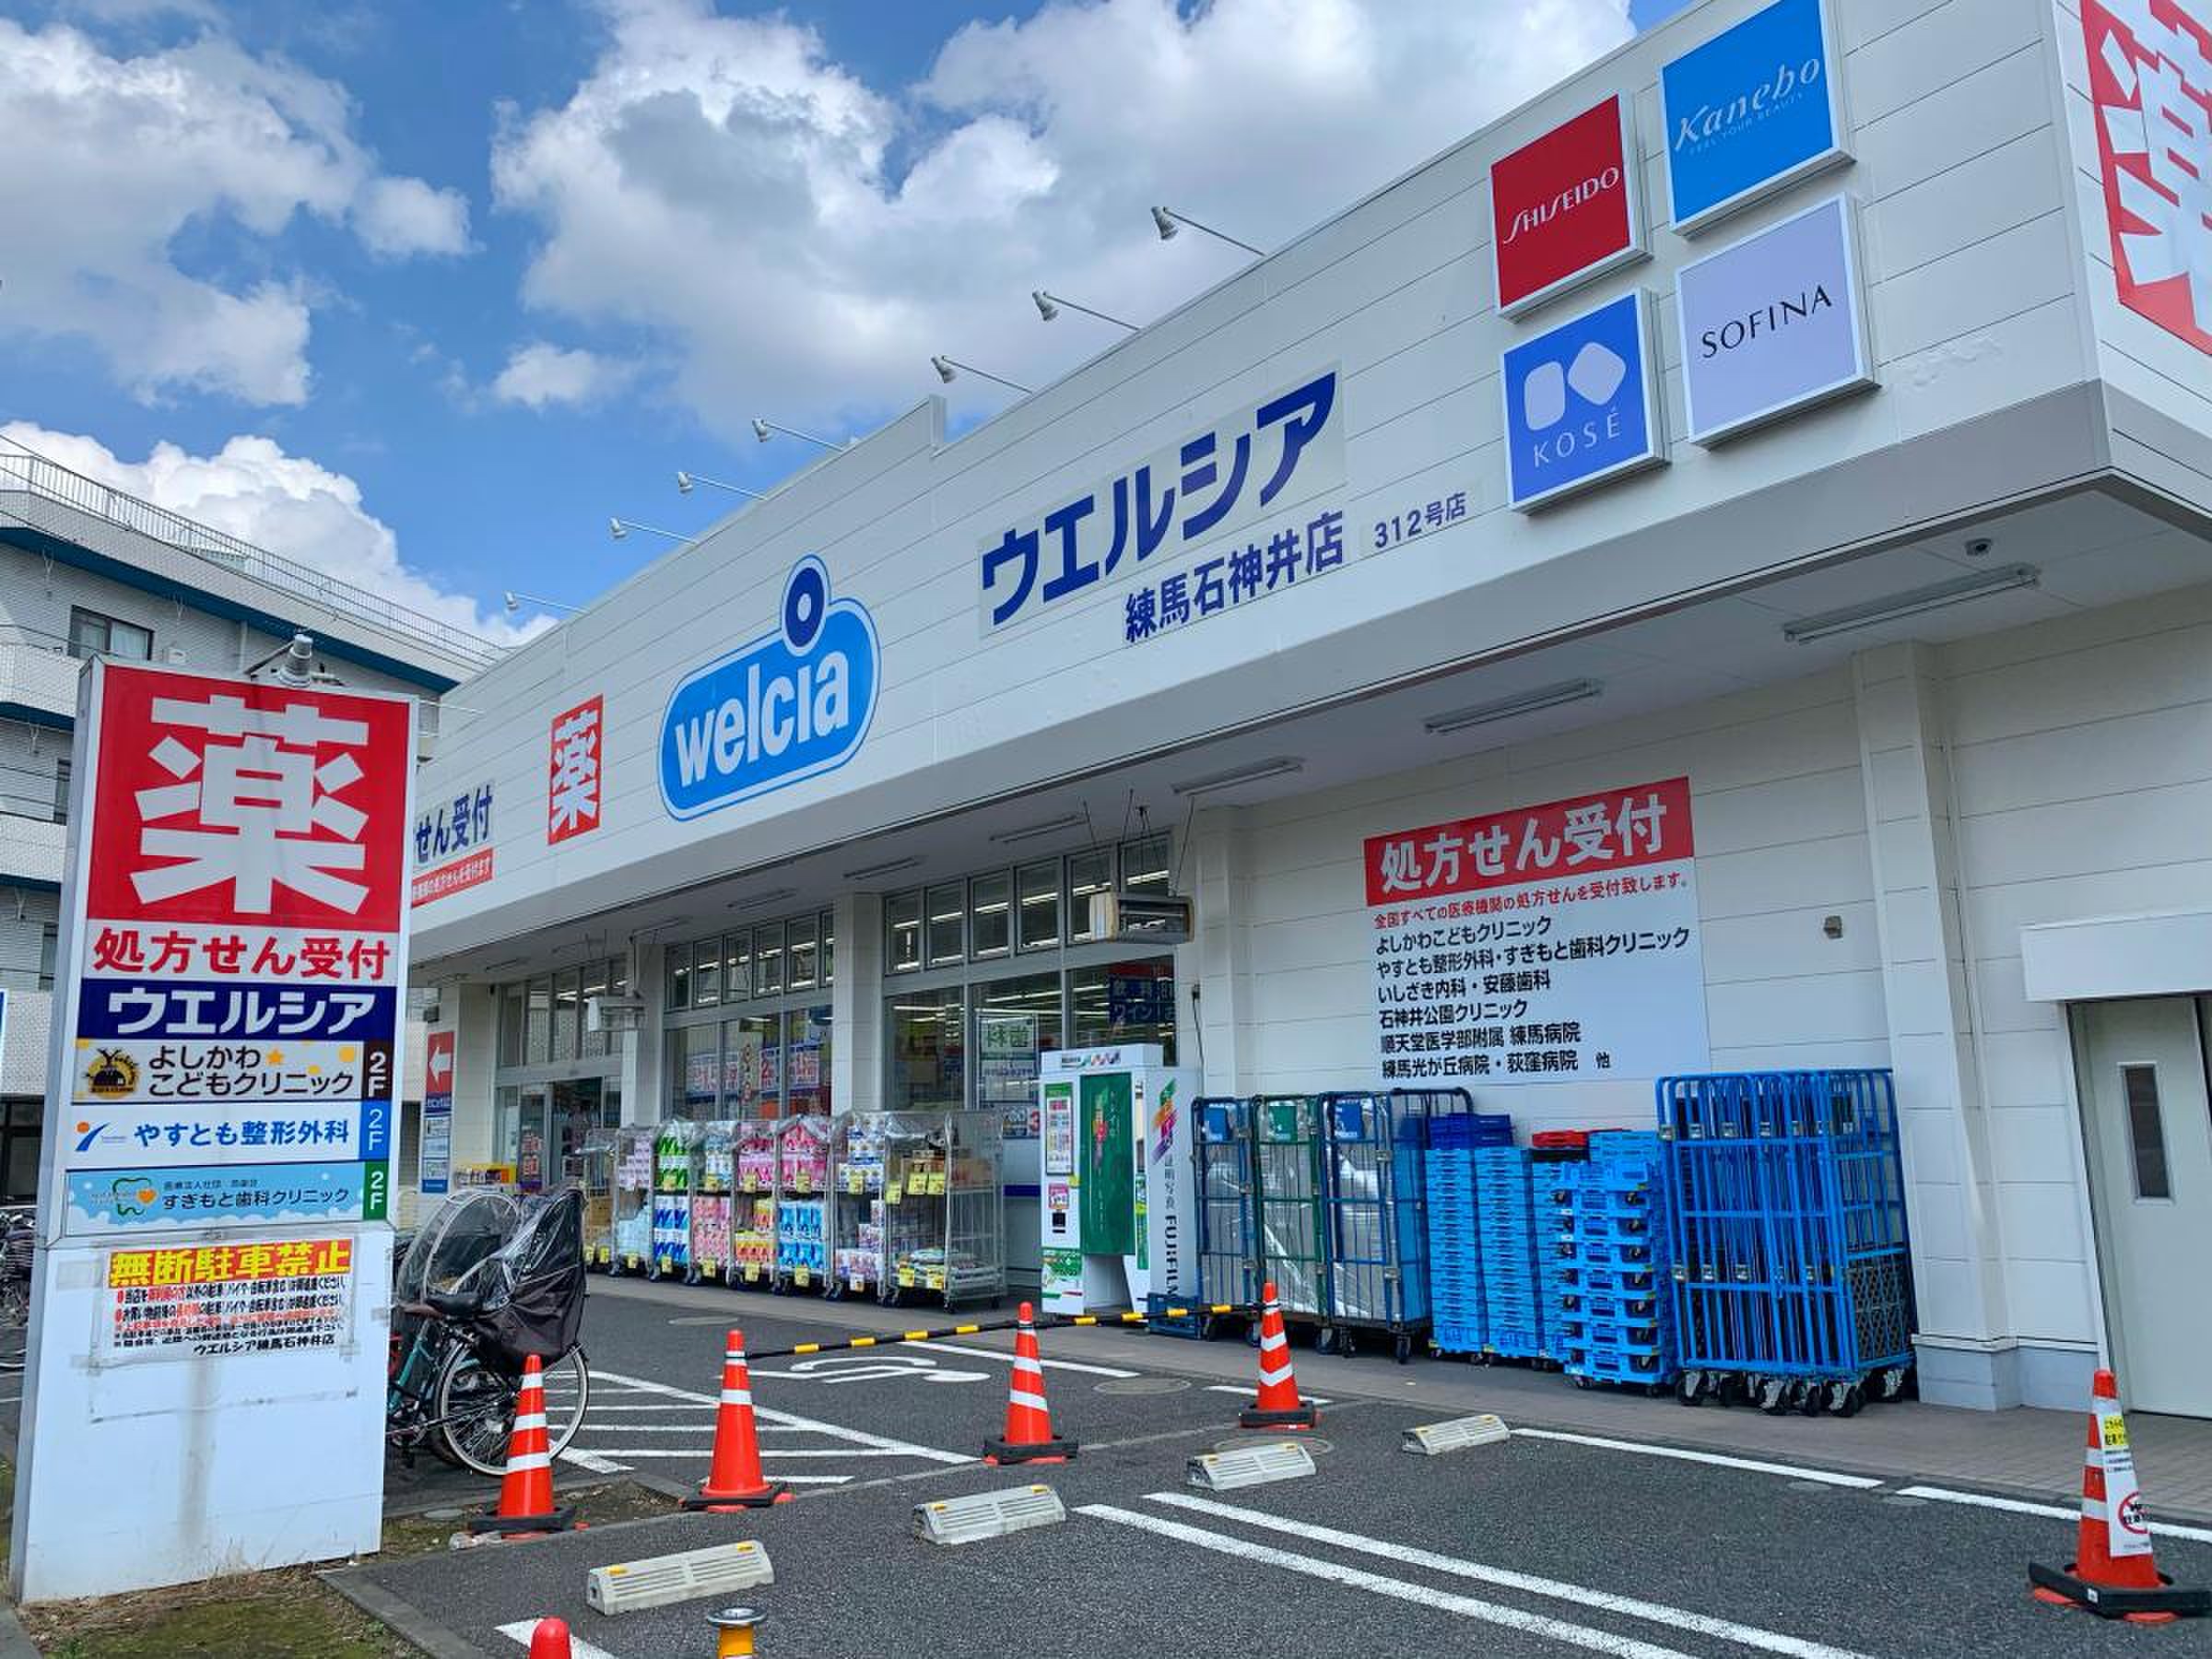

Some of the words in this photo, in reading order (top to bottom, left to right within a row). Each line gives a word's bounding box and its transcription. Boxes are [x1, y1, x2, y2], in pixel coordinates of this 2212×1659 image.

[1675, 58, 1820, 152] Kanebo
[1503, 167, 1619, 244] SHISEIDO
[1701, 284, 1832, 359] SOFINA
[1533, 407, 1620, 468] KOSÉ
[982, 371, 1336, 626] ウエルシア
[1374, 491, 1466, 548] 312号店
[1125, 509, 1343, 642] 練馬石神井店
[675, 651, 849, 789] welcia
[552, 708, 598, 834] 薬
[130, 694, 370, 914] 薬
[1380, 794, 1666, 892] 処方せん受付
[94, 927, 391, 980] 処方せん受付
[1376, 915, 1551, 955] よしかわこどもクリニック
[108, 988, 376, 1035] ウエルシア
[1379, 998, 1528, 1030] 石神井公園クリニック
[1510, 1021, 1581, 1045] 練馬病院
[148, 1045, 262, 1069] よしかわ
[148, 1070, 354, 1098] こどもクリニック
[134, 1120, 350, 1147] やすとも整形外科
[162, 1188, 350, 1210] すぎもと歯科クリニック
[109, 1241, 351, 1287] 無断駐車禁止
[194, 1334, 335, 1356] ウエルシア練馬石神井店
